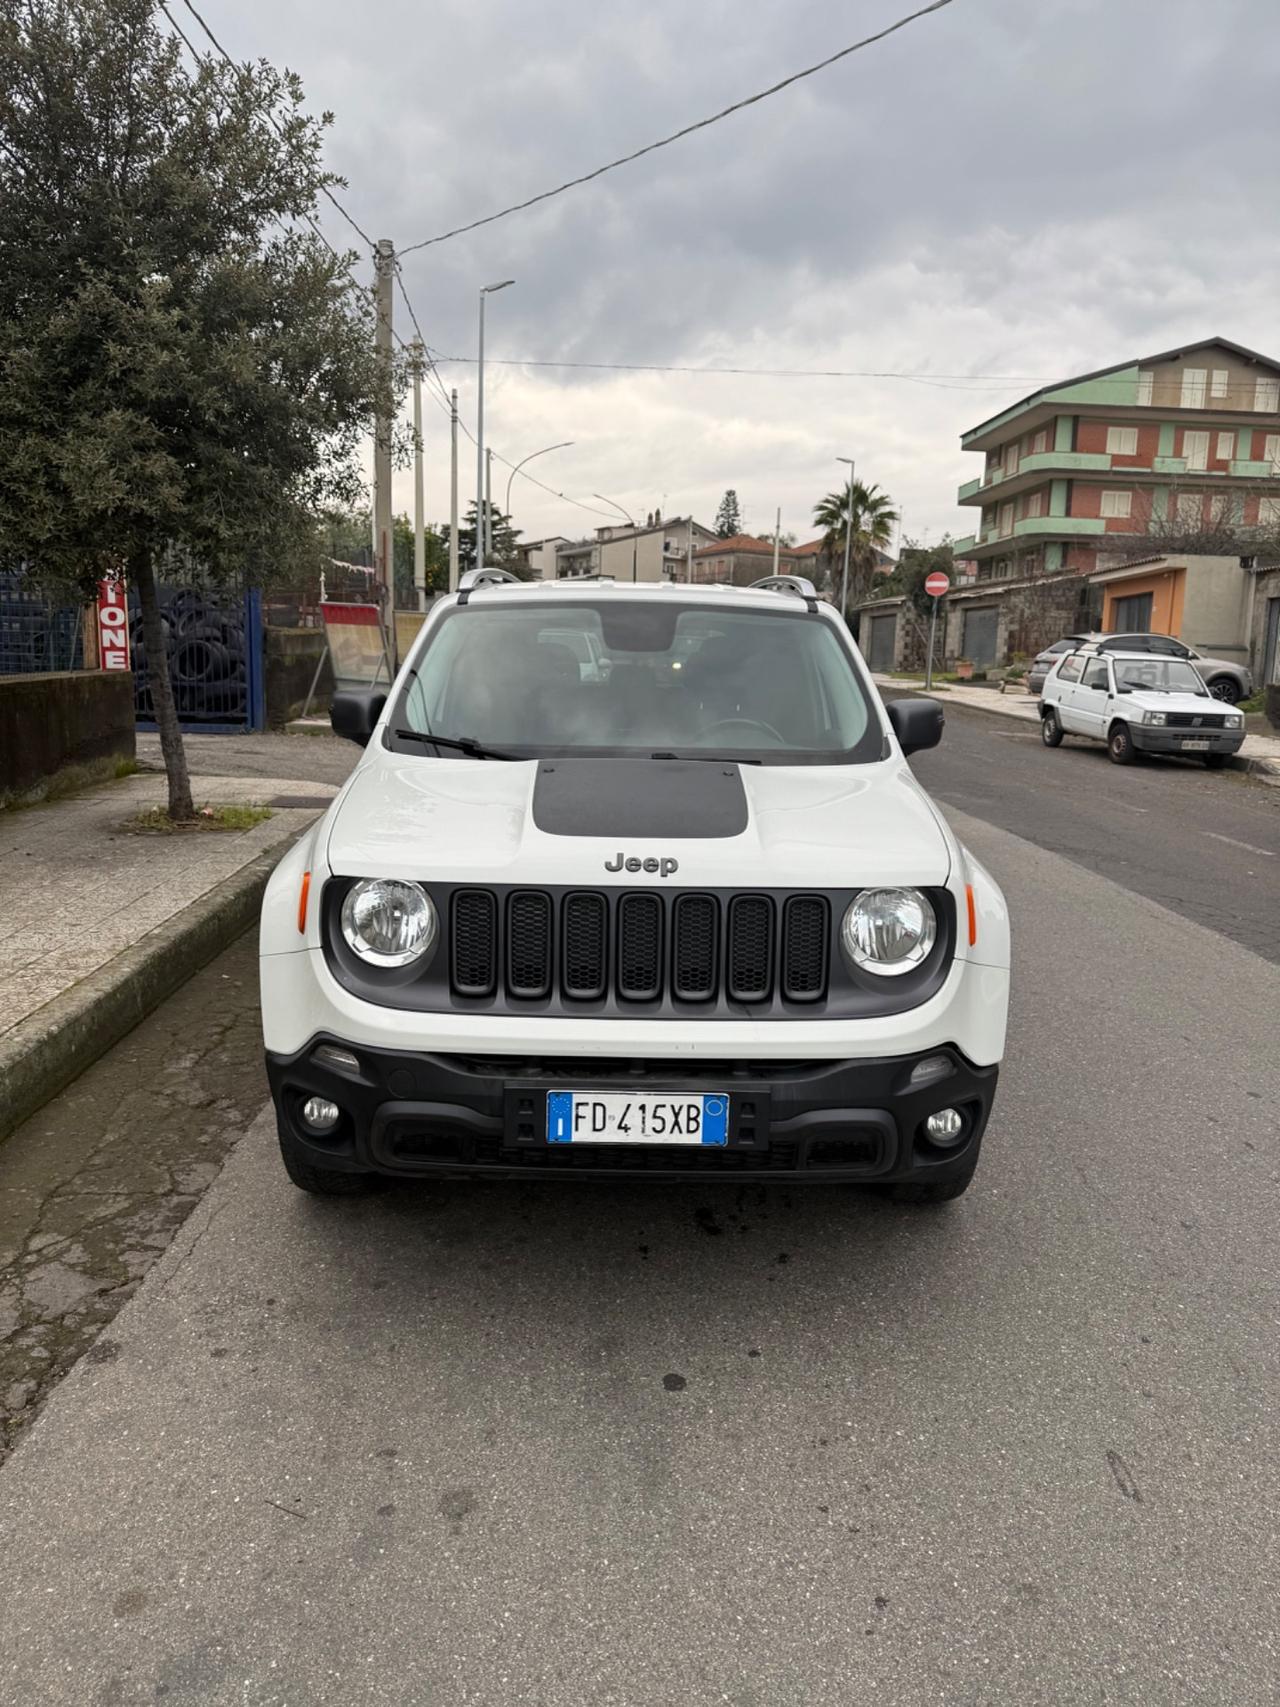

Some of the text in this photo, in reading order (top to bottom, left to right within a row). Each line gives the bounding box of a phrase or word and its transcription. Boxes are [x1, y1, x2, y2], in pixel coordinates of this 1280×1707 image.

[604, 852, 679, 877] Jeep
[574, 1101, 606, 1133] FD
[616, 1103, 701, 1135] 415XB
